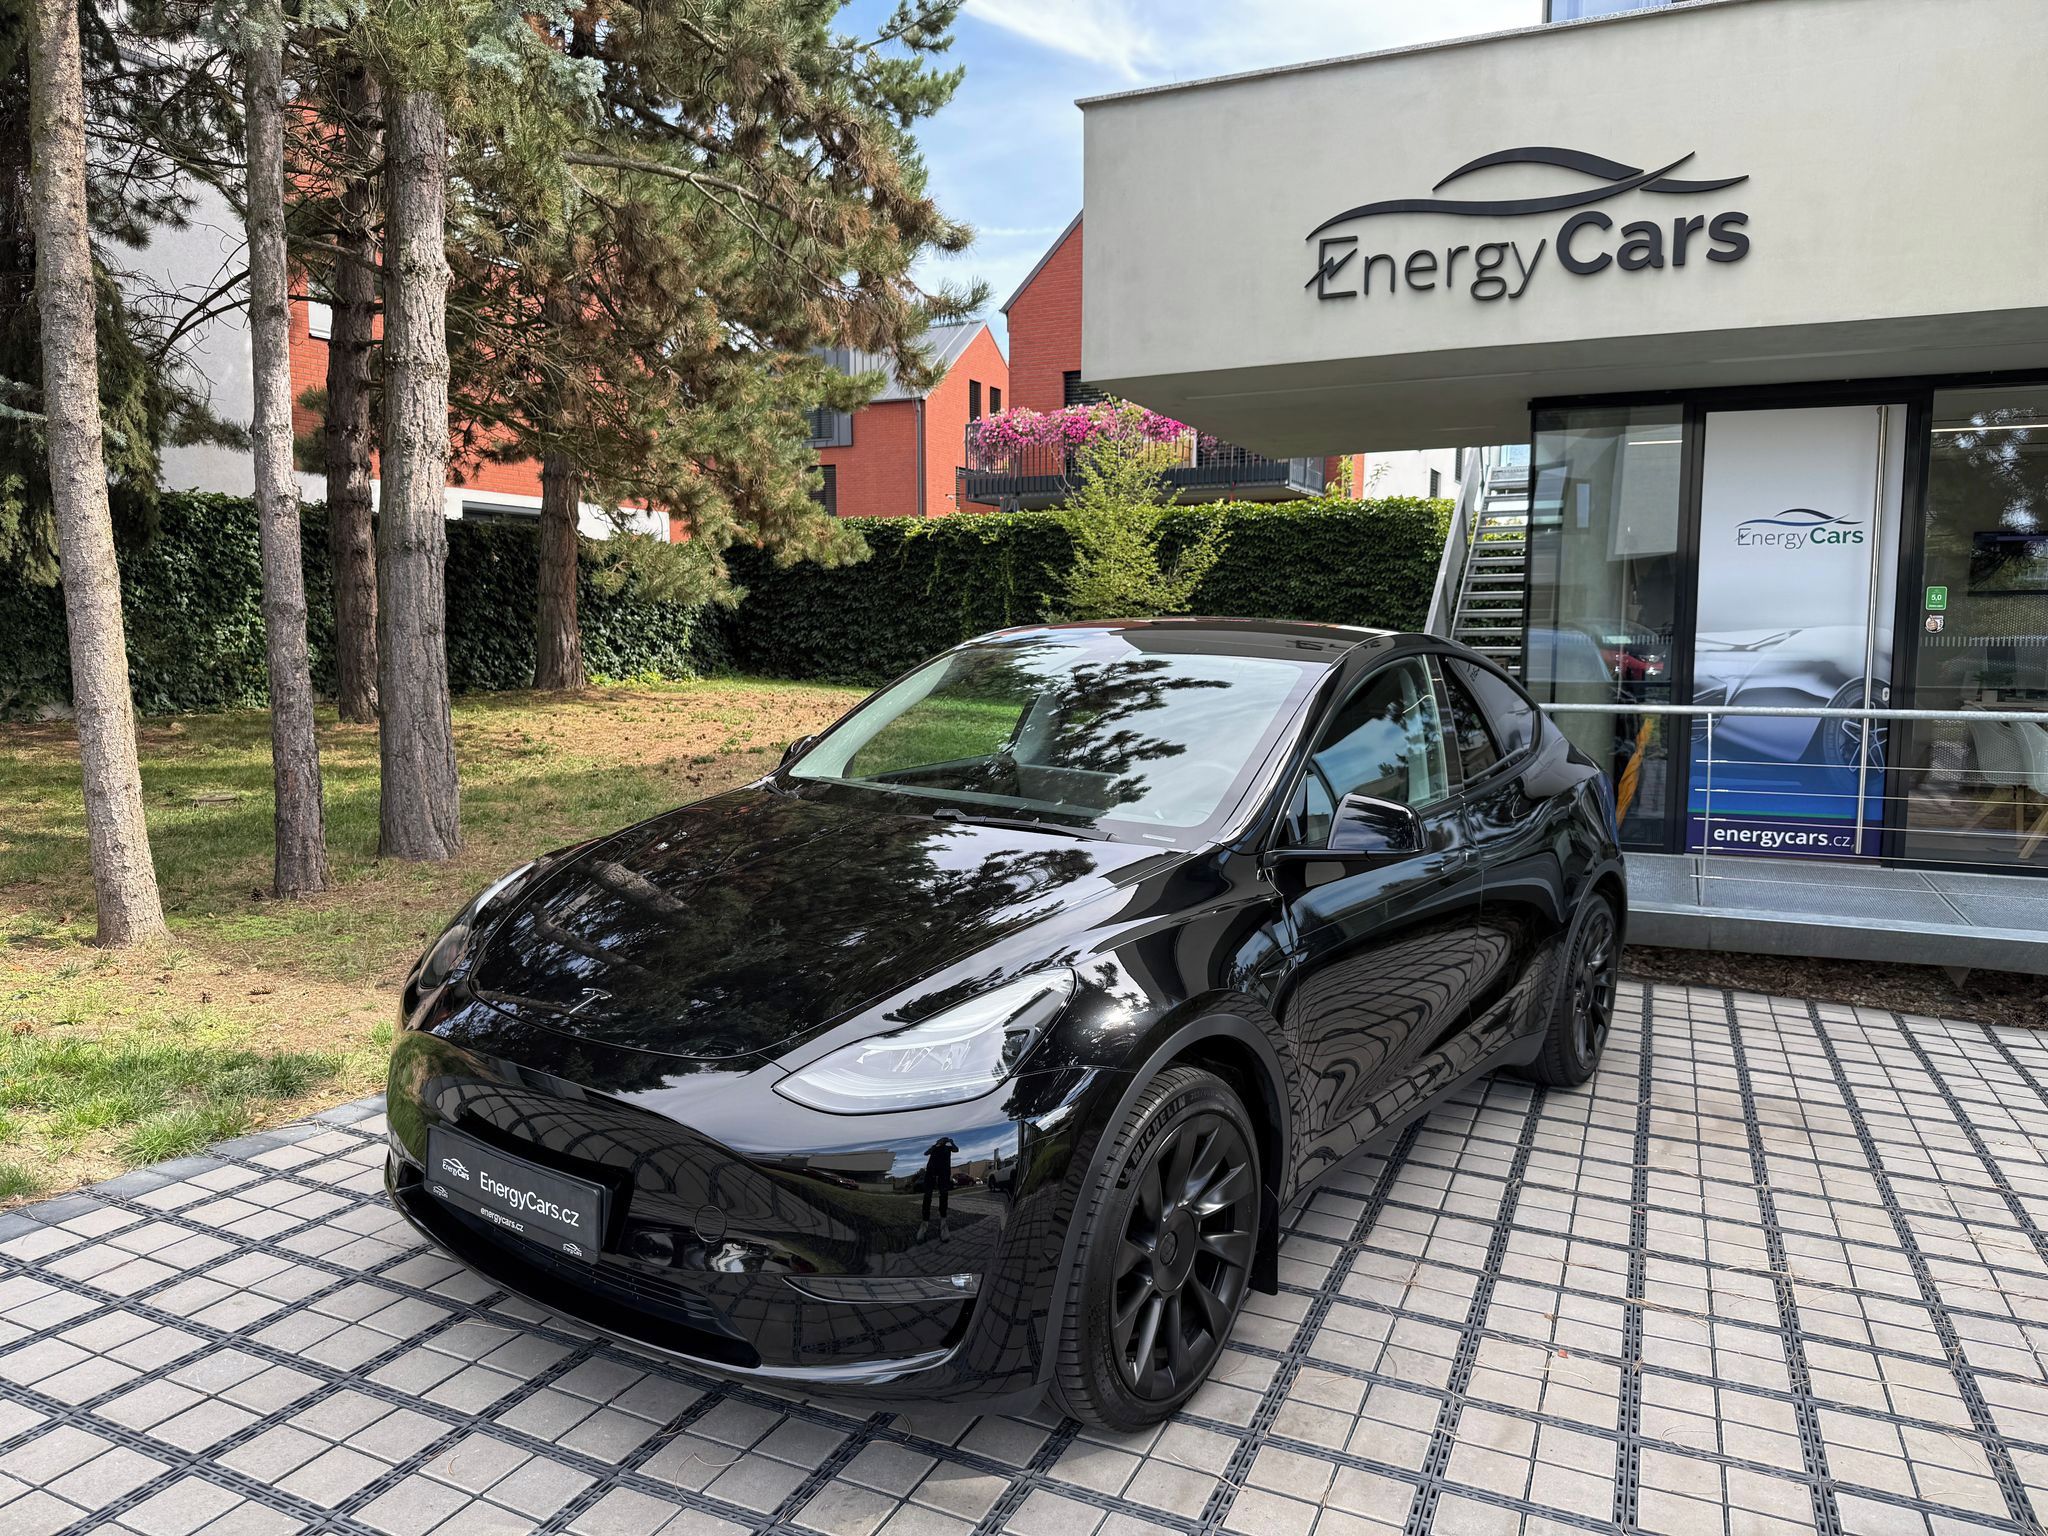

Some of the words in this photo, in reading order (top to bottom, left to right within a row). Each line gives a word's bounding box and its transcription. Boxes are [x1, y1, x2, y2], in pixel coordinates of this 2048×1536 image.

[1713, 827, 1850, 848] energycars.cz
[1131, 1095, 1187, 1166] MICHELIN
[442, 1160, 470, 1181] EnergyCars
[480, 1171, 580, 1228] EnergyCars.cz
[480, 1207, 524, 1232] energycars.cz
